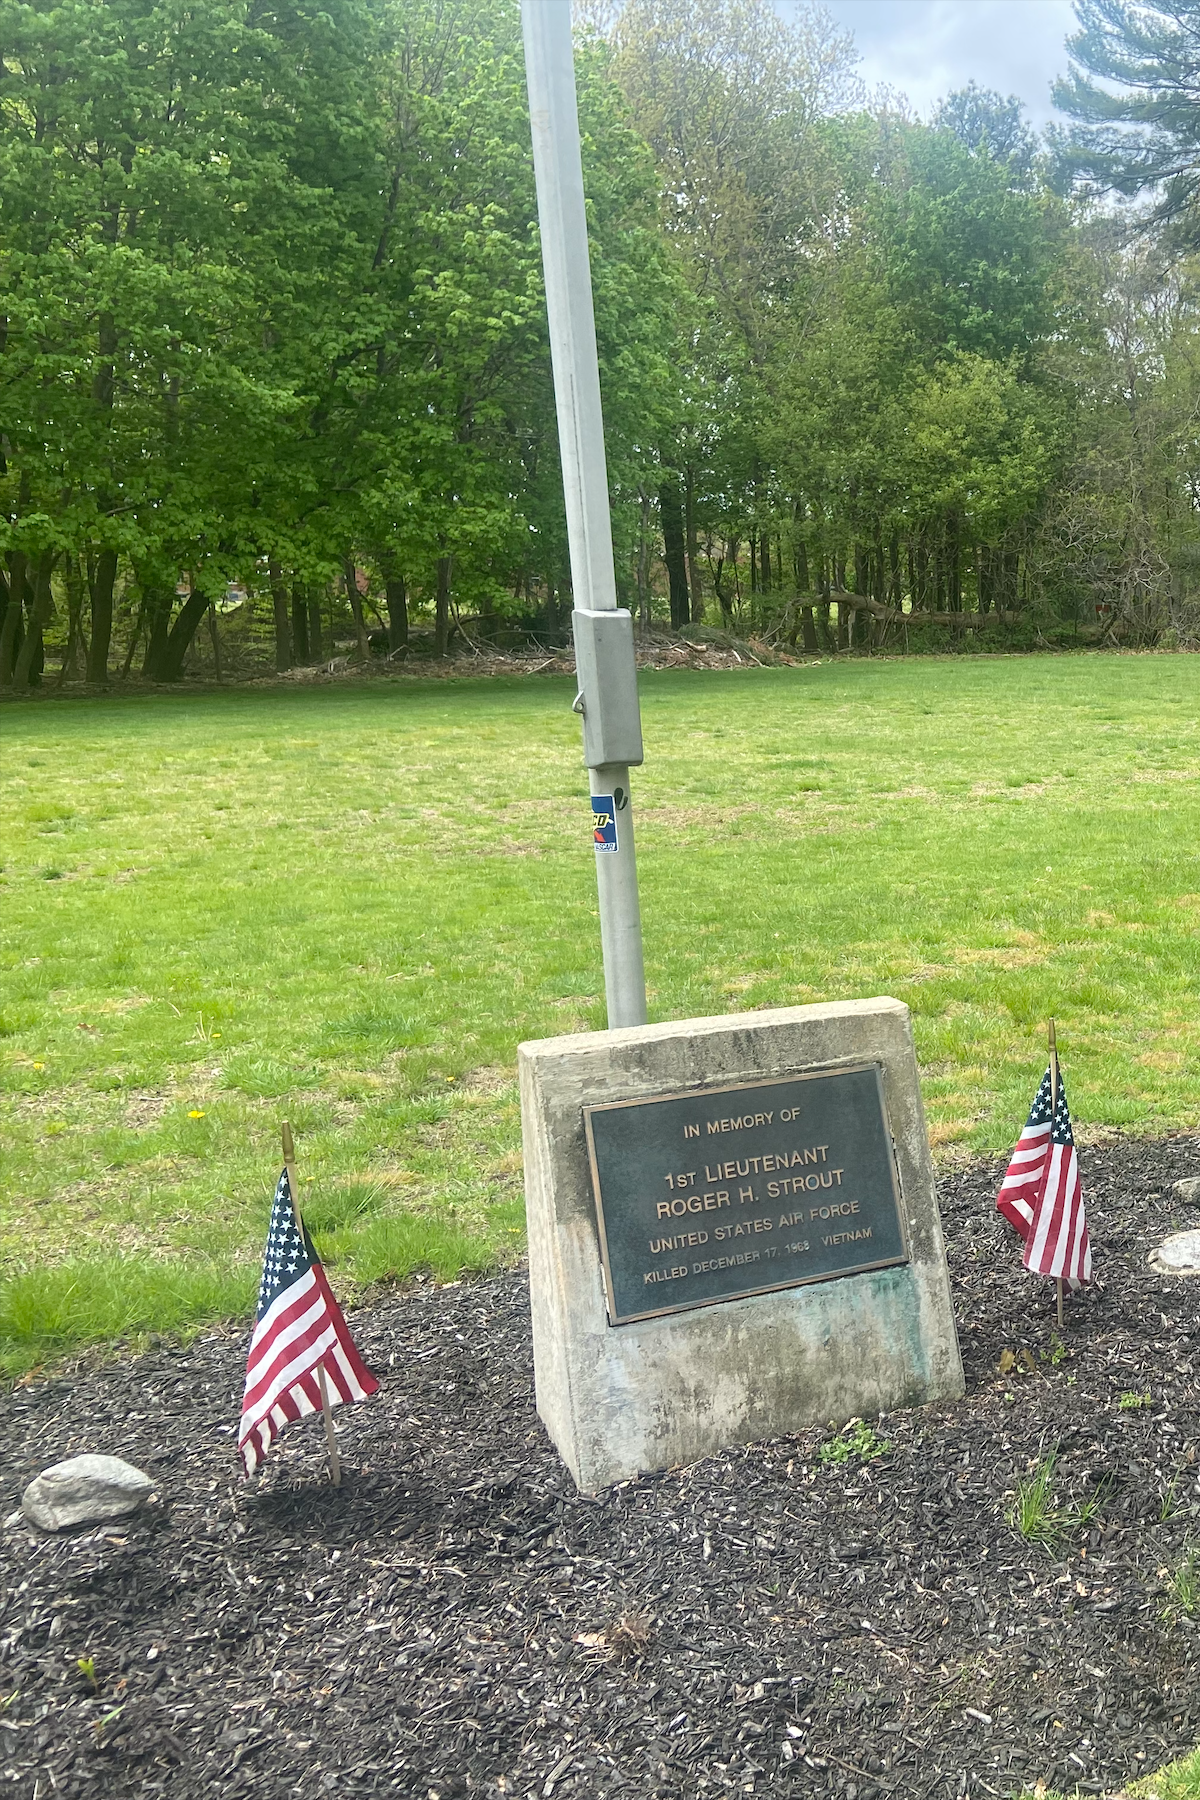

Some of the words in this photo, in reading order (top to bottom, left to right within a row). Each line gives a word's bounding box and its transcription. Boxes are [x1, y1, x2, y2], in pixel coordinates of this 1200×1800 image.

[683, 1124, 701, 1139] IN
[707, 1111, 774, 1134] MEMORY
[780, 1107, 801, 1122] OF
[664, 1172, 697, 1190] 1ST
[705, 1145, 829, 1183] LIEUTENANT
[656, 1190, 731, 1220] ROGER
[739, 1185, 760, 1204] H.
[767, 1169, 844, 1198] STROUT
[649, 1231, 709, 1254] UNITED
[714, 1218, 773, 1241] STATES
[779, 1211, 804, 1228] AIR
[810, 1200, 861, 1221] FORCE
[643, 1266, 688, 1285] KILLED
[692, 1250, 760, 1275] DECEMBER
[821, 1226, 873, 1247] VIETNAM
